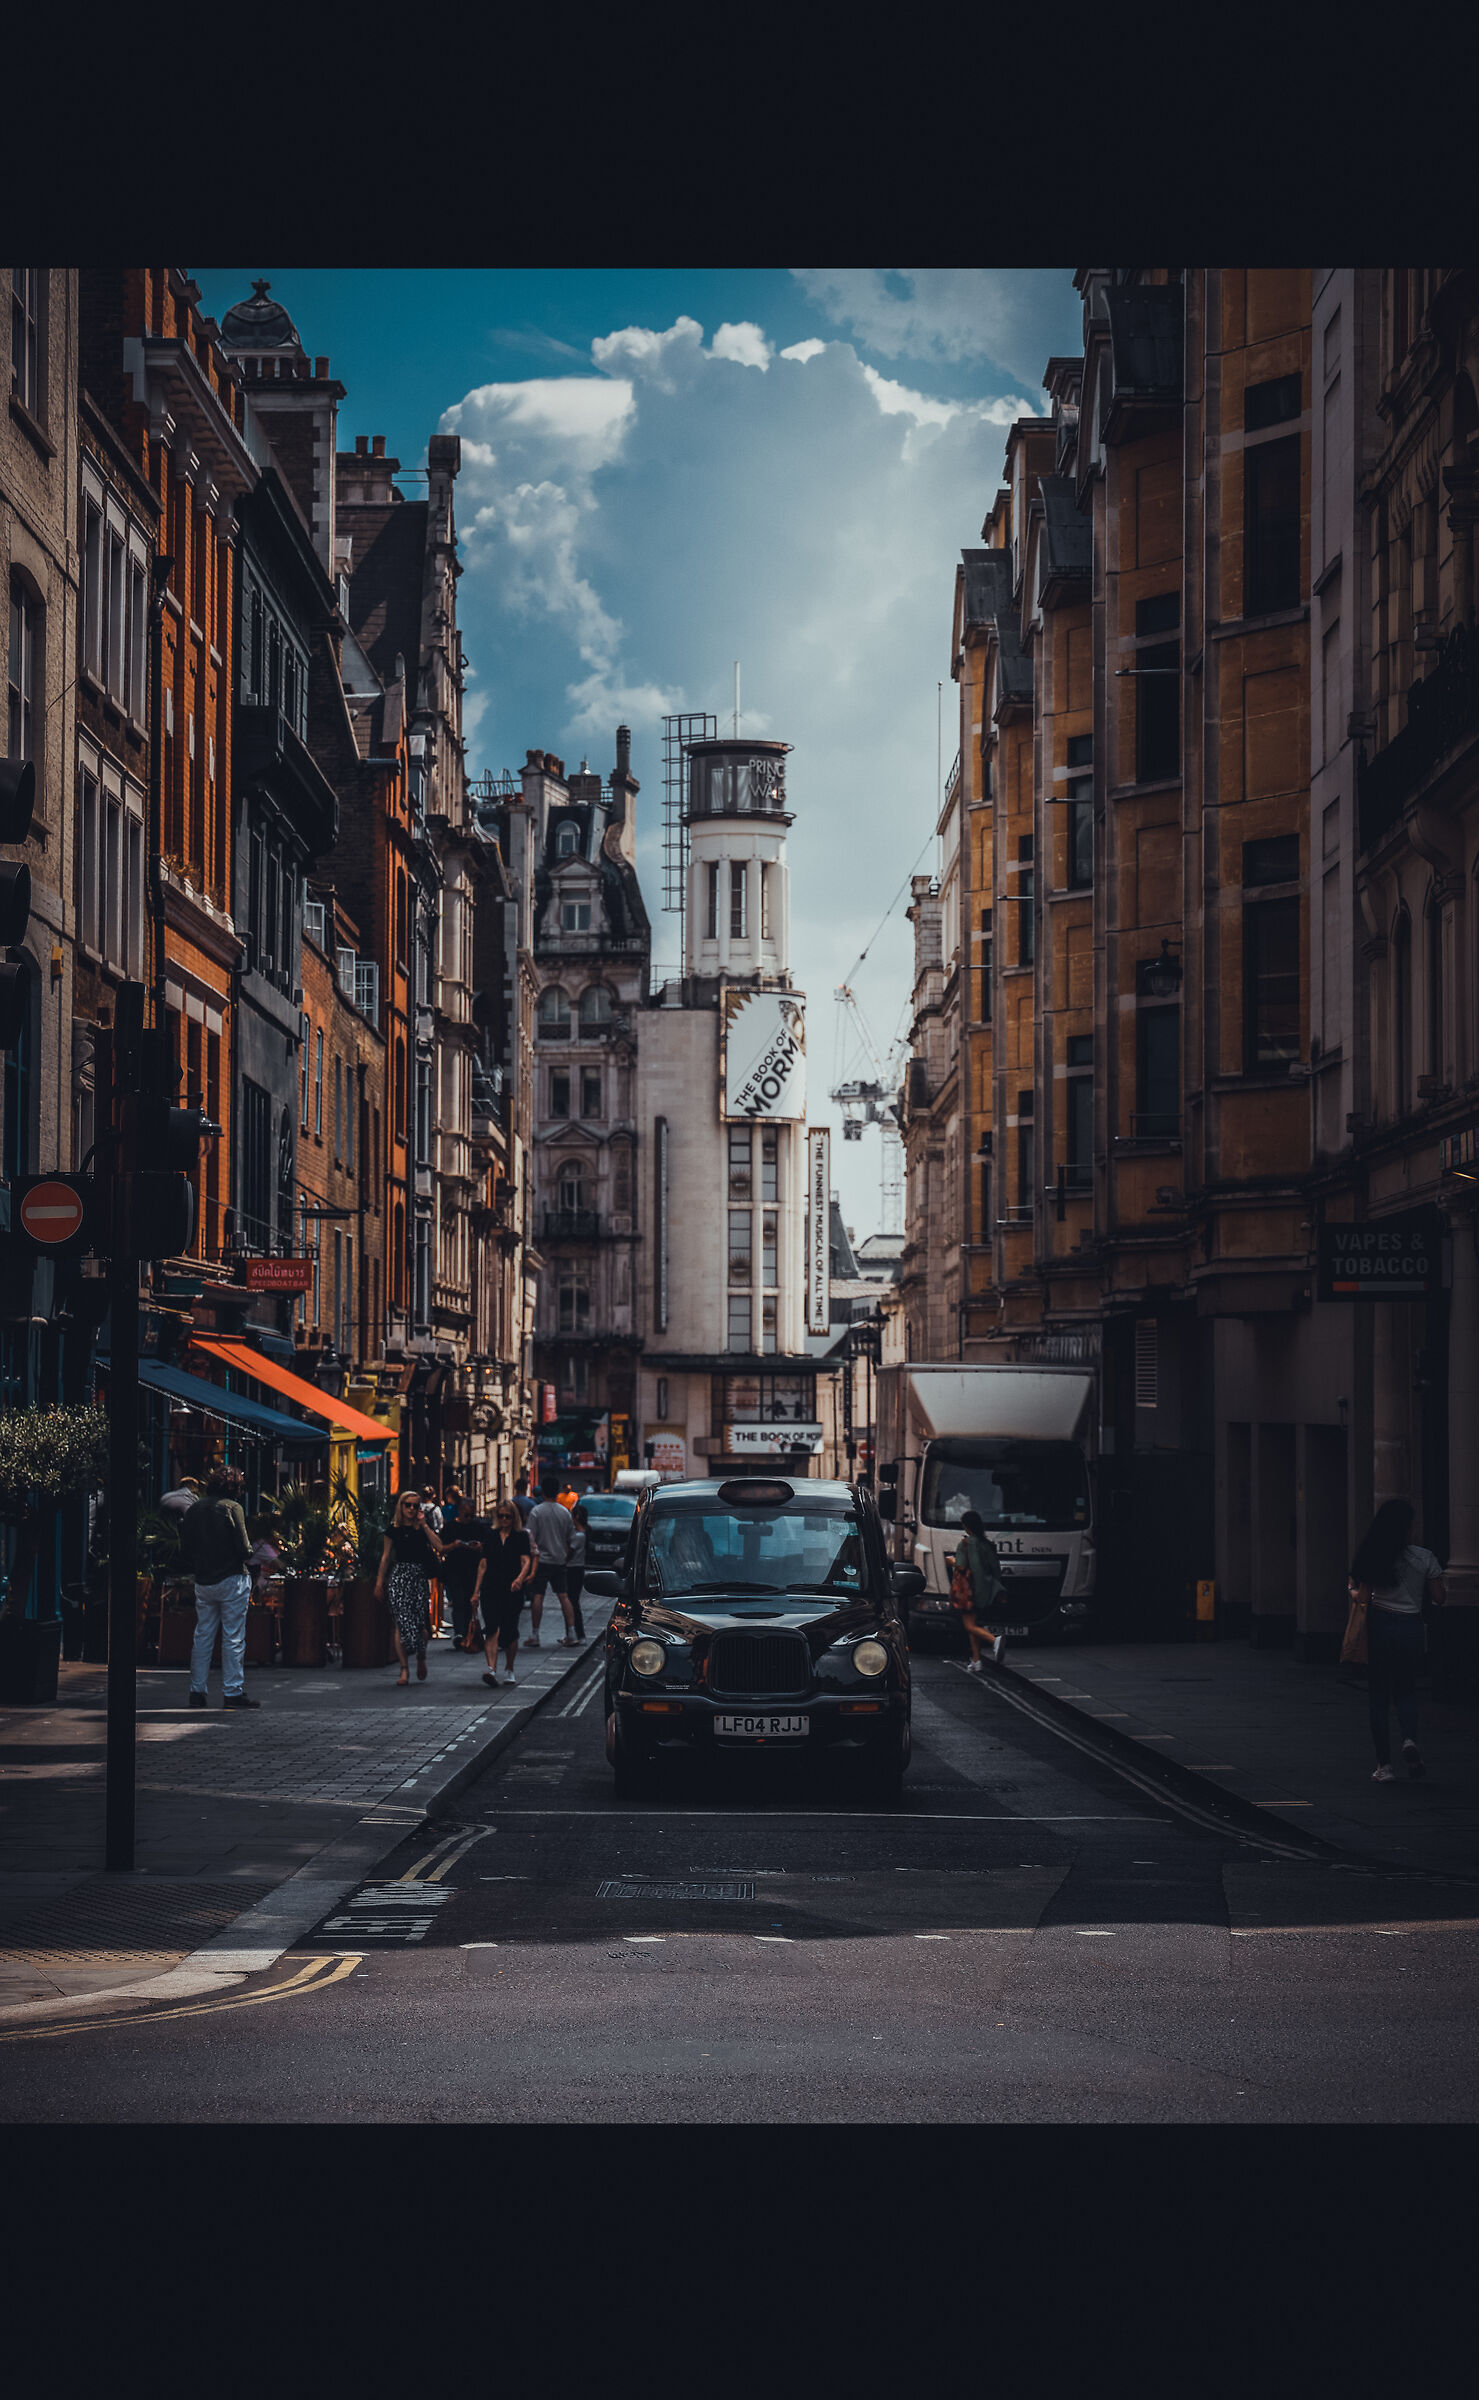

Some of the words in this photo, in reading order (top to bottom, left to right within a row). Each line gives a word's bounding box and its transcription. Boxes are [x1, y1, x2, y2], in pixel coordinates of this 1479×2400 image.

[749, 759, 785, 778] PRINC
[733, 1082, 756, 1108] THE
[751, 1047, 780, 1084] BOOK
[776, 1028, 788, 1047] OF
[743, 1036, 800, 1118] MORM
[815, 1163, 824, 1211] FUNNIEST
[815, 1214, 824, 1257] MUSICAL
[1334, 1232, 1403, 1251] VAPES
[1410, 1232, 1425, 1251] &
[815, 1259, 824, 1273] OF
[1331, 1256, 1429, 1275] TOBACCO
[815, 1275, 824, 1293] ALL
[735, 1432, 757, 1441] THE
[760, 1432, 791, 1441] BOOK
[793, 1432, 804, 1440] OF
[998, 1538, 1025, 1554] nt
[722, 1717, 766, 1732] LF04
[769, 1717, 803, 1733] RJJ
